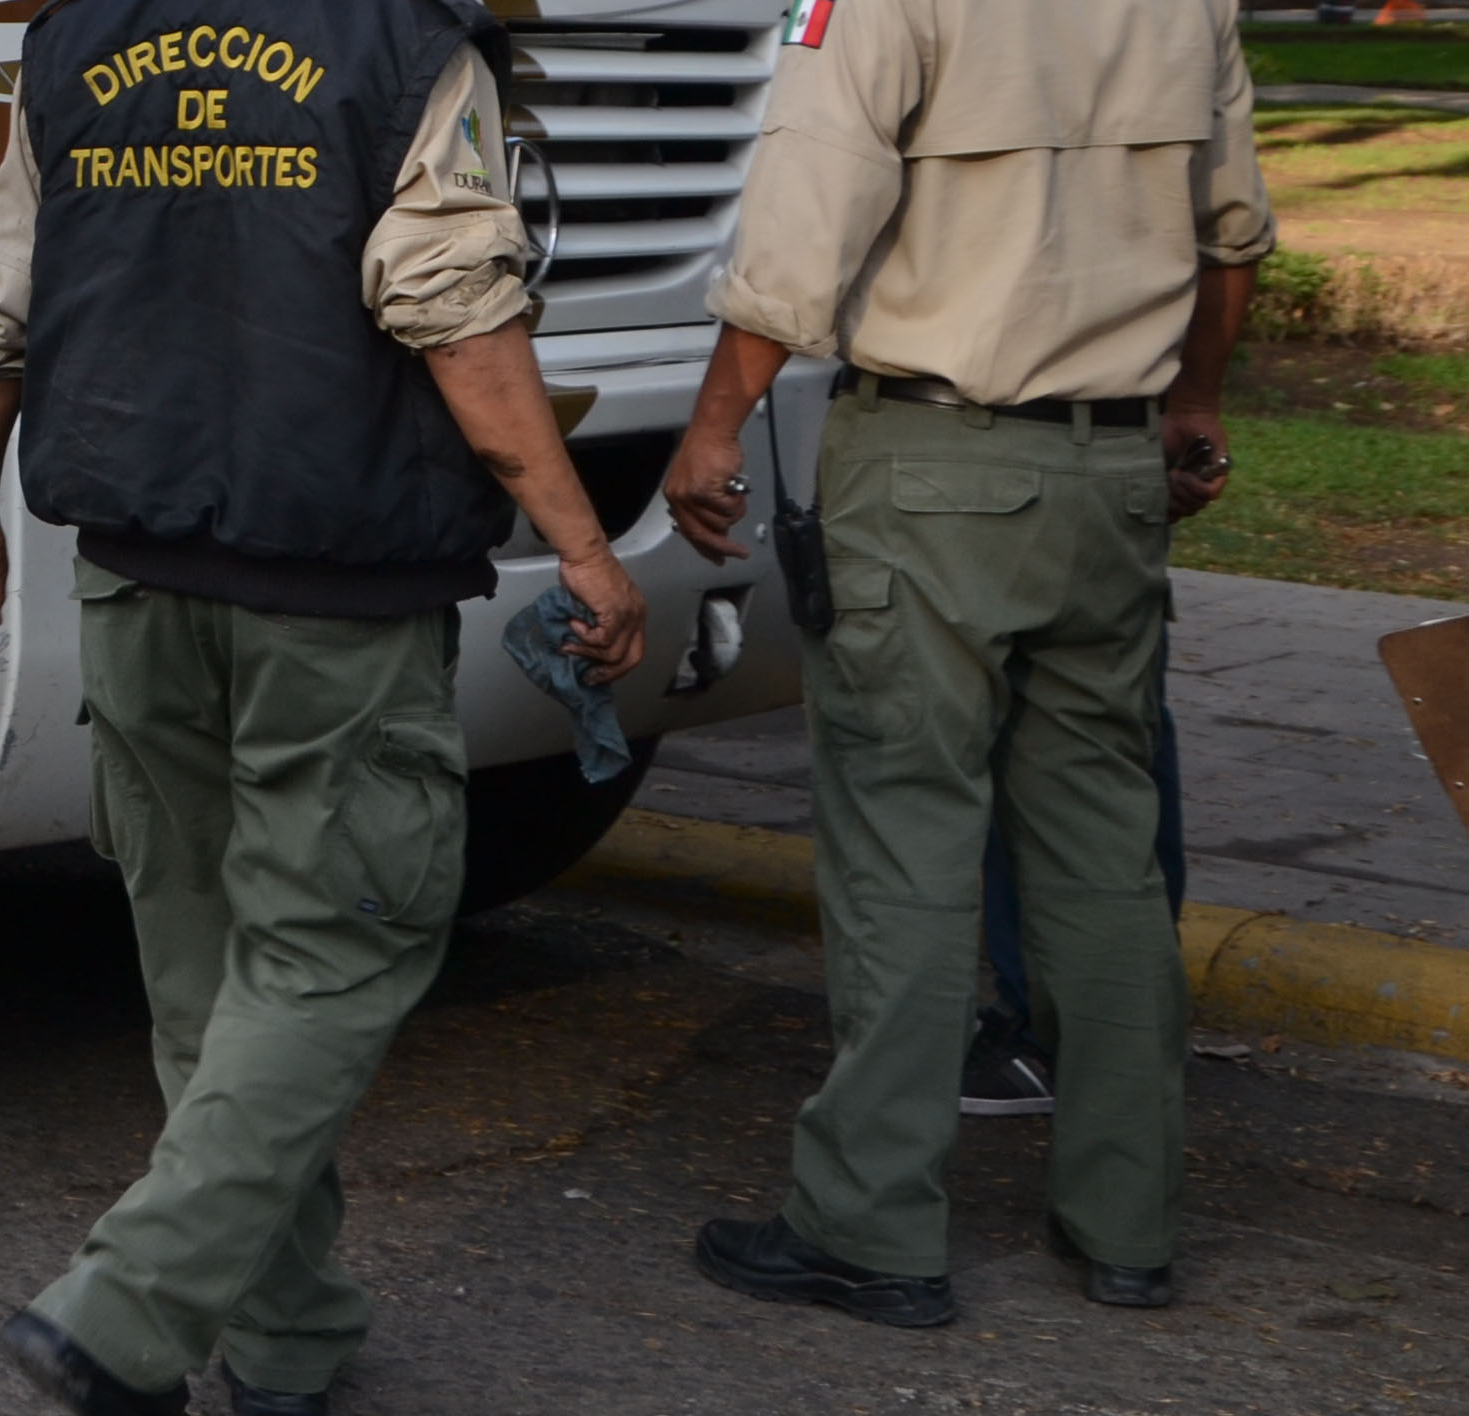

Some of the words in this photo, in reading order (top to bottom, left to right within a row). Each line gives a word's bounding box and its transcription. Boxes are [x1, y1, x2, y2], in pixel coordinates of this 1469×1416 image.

[82, 24, 326, 107] DIRECCION
[177, 89, 229, 131] DE
[70, 144, 319, 190] TRANSPORTES
